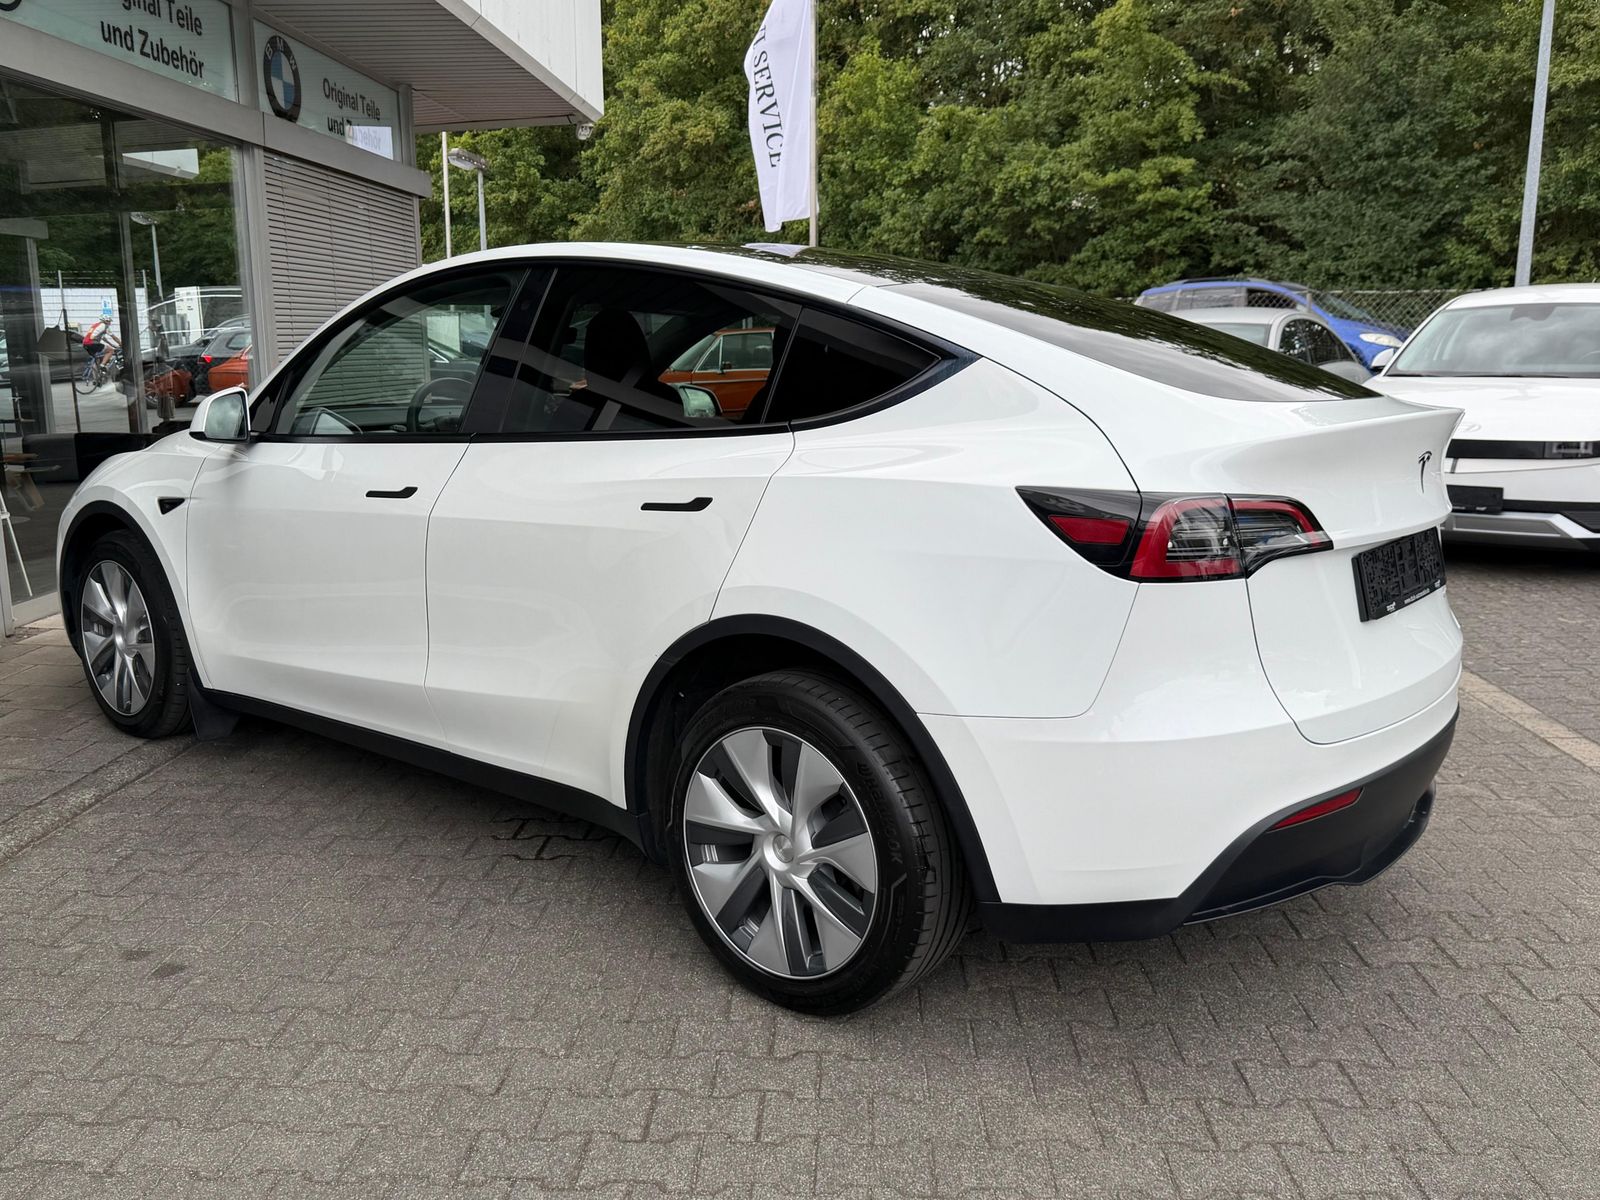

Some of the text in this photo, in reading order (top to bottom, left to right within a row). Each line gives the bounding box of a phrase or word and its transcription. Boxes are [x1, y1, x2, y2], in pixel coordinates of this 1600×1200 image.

[166, 0, 203, 36] Teile
[100, 20, 204, 78] und Zubehör
[266, 36, 297, 70] BMW
[322, 77, 381, 121] Original Teile
[753, 50, 784, 168] SERVICE
[327, 116, 345, 136] und
